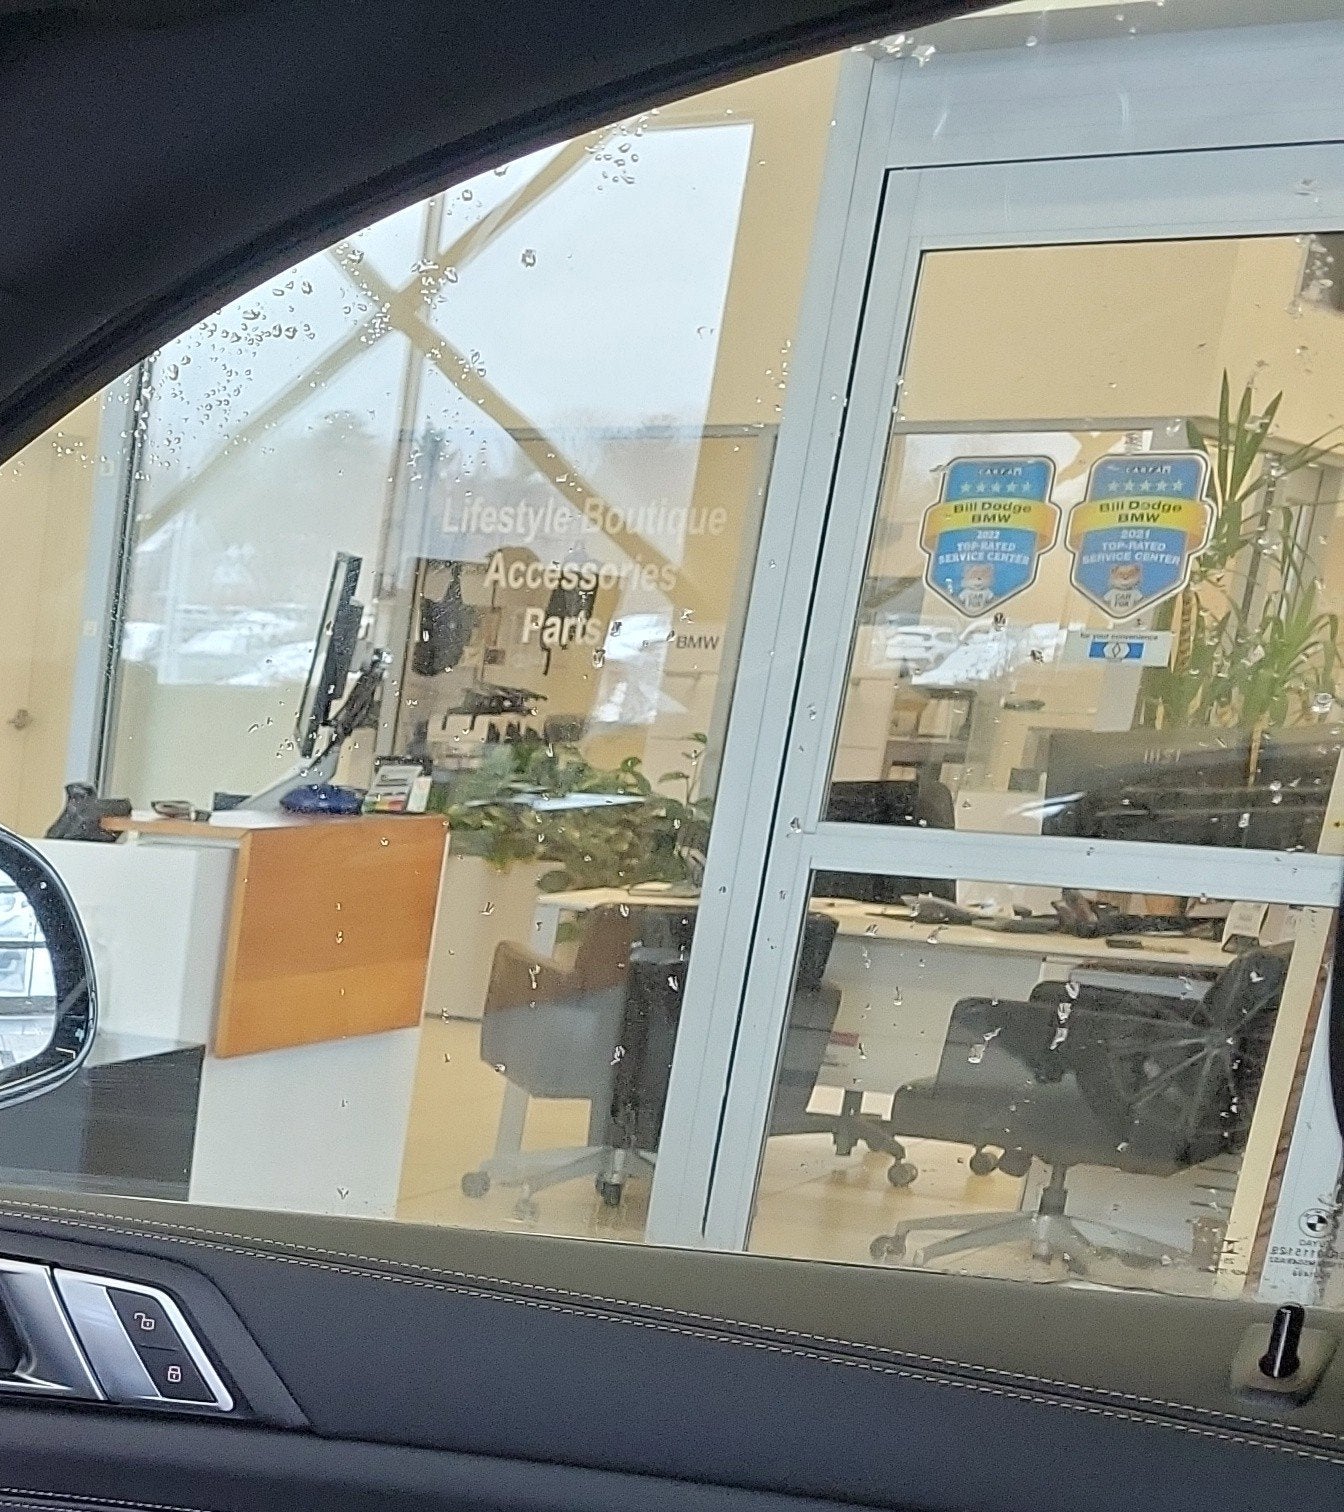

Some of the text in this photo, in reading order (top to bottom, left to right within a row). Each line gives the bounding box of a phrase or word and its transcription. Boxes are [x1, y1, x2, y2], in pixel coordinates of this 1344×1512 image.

[954, 502, 1032, 514] Bill Dodge
[1099, 501, 1182, 513] Bill Dodge
[441, 498, 727, 545] Lifestyle Boutique
[971, 514, 1011, 523] BMW
[1117, 513, 1160, 523] BMW
[1102, 542, 1166, 551] TOP-RATED
[938, 552, 985, 565] SERVICE
[1082, 552, 1181, 565] SERVICE CENTER
[484, 552, 677, 591] Accessories
[522, 607, 602, 646] Parts
[675, 635, 720, 649] BMW
